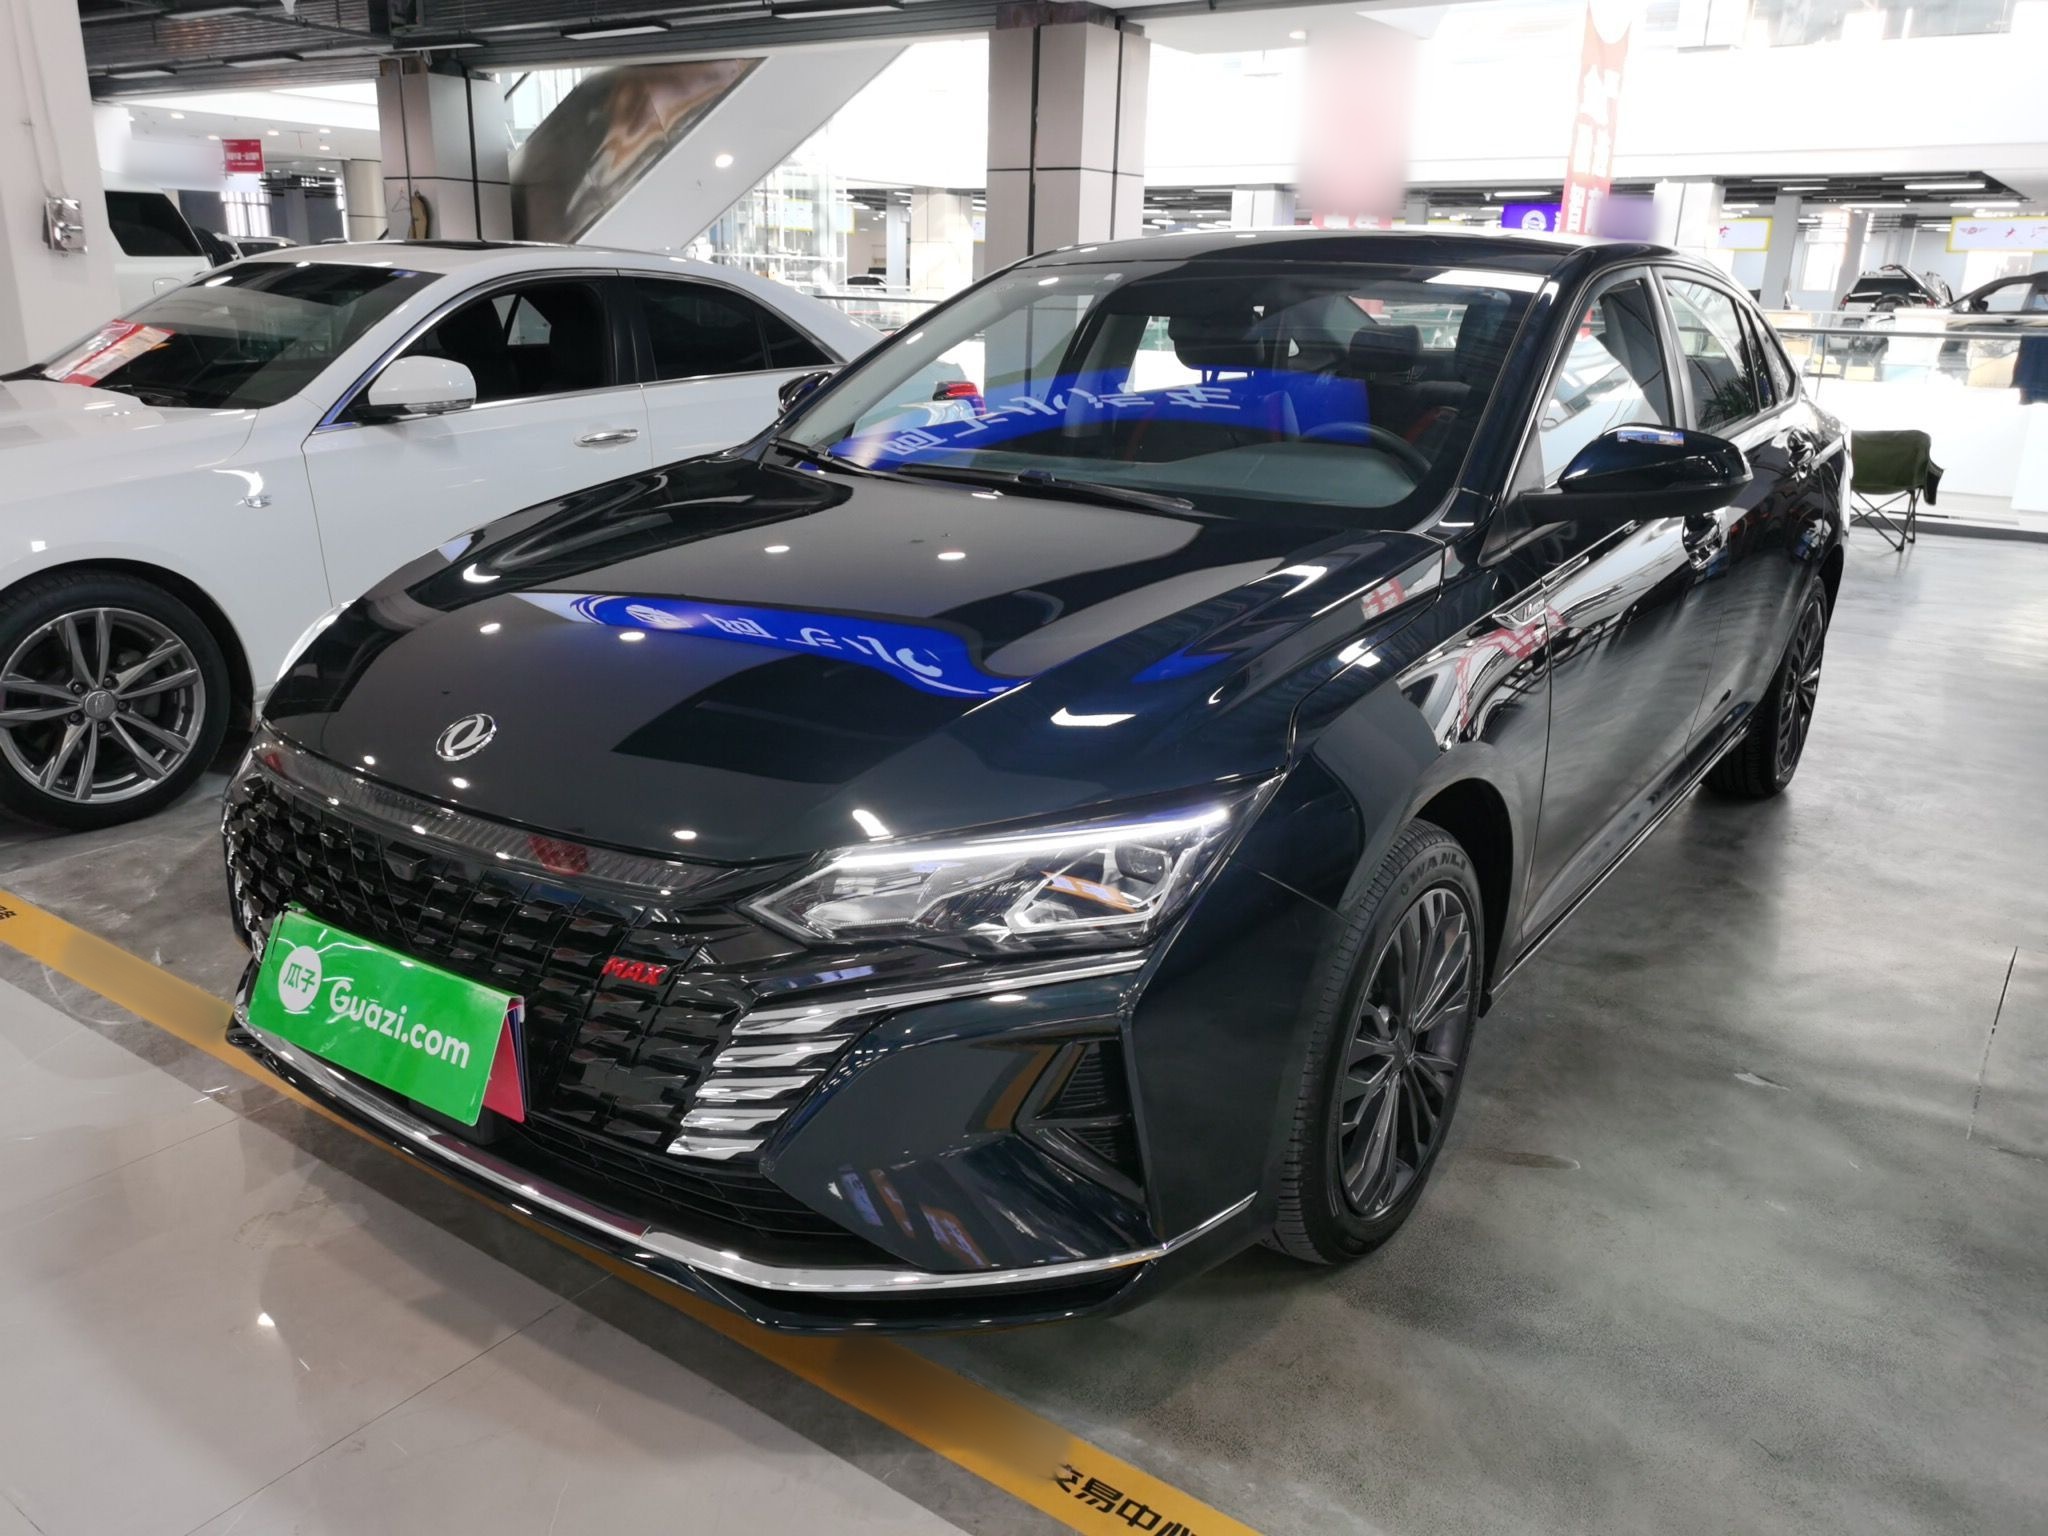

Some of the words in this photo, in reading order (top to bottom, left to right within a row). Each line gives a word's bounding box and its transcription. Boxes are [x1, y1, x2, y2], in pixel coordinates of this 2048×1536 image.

[283, 963, 316, 993] 瓜子
[602, 956, 667, 986] MAX
[329, 980, 470, 1069] Guazi.com
